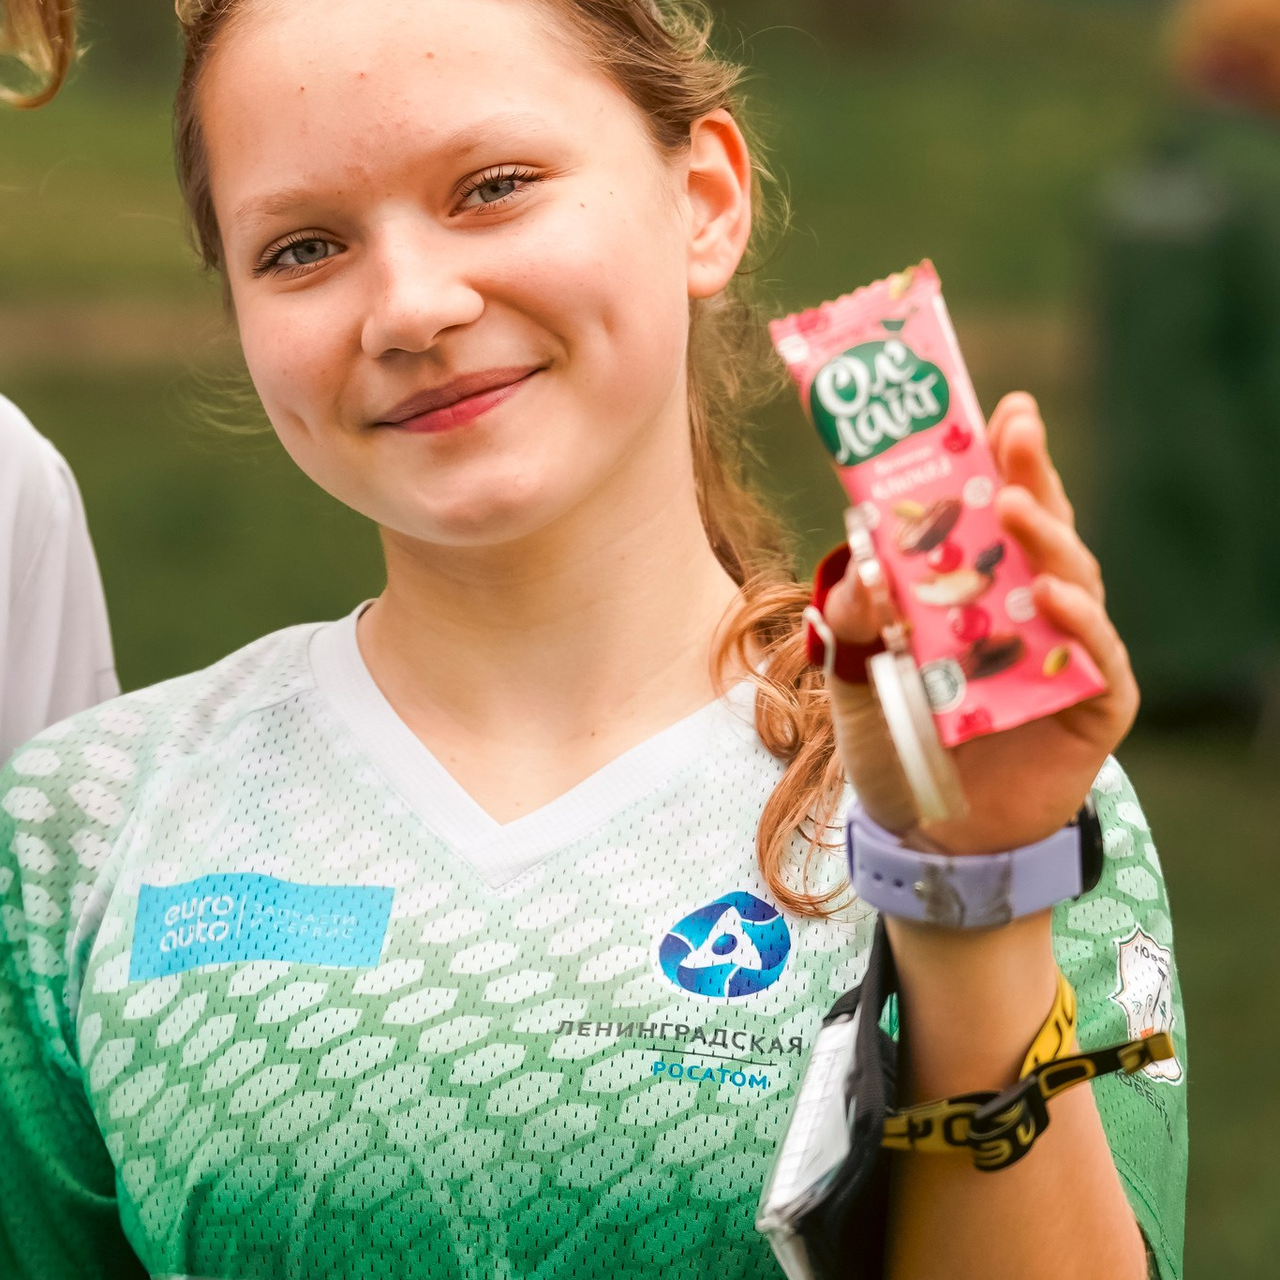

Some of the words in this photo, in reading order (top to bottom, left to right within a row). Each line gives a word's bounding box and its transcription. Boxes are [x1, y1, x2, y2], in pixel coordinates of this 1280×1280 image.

[164, 894, 234, 926] euro
[160, 918, 230, 953] auto
[554, 1020, 803, 1054] ЛЕНИНГРАДСКАЯ
[652, 1061, 768, 1090] РОСАТОМ
